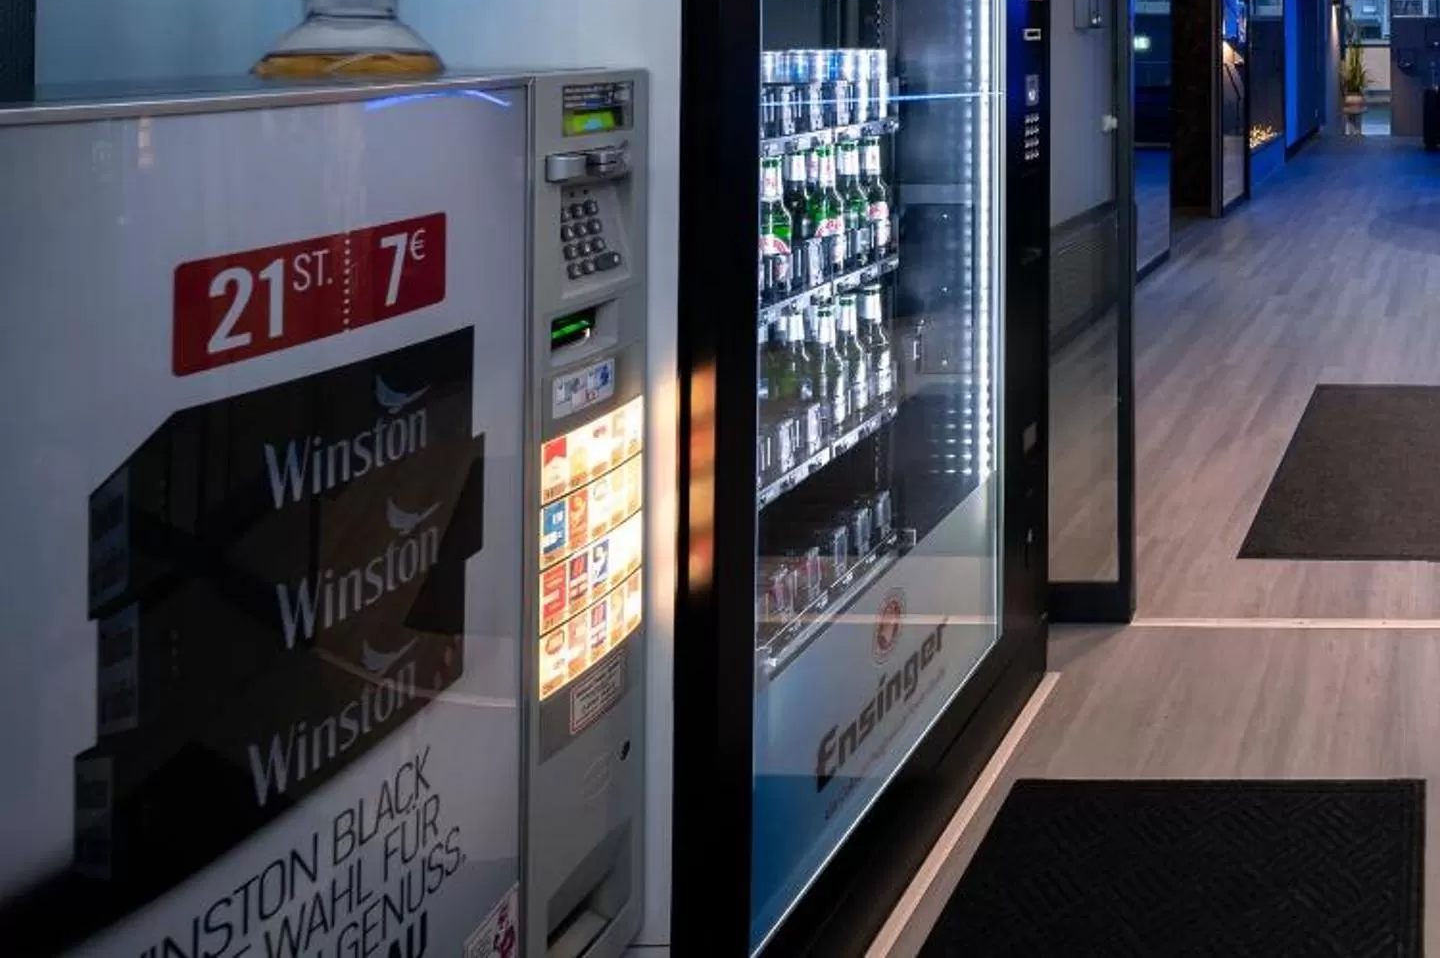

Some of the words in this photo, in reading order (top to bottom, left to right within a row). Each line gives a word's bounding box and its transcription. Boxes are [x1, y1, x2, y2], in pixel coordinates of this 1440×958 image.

[207, 257, 285, 355] 21
[264, 407, 428, 510] Winston
[276, 526, 439, 649] Winston
[248, 660, 416, 807] Winston
[816, 616, 949, 792] Ensinger
[139, 831, 319, 958] NSTON
[333, 743, 430, 866] BLACK
[264, 858, 374, 958] WAHL
[383, 793, 440, 882] FÜR
